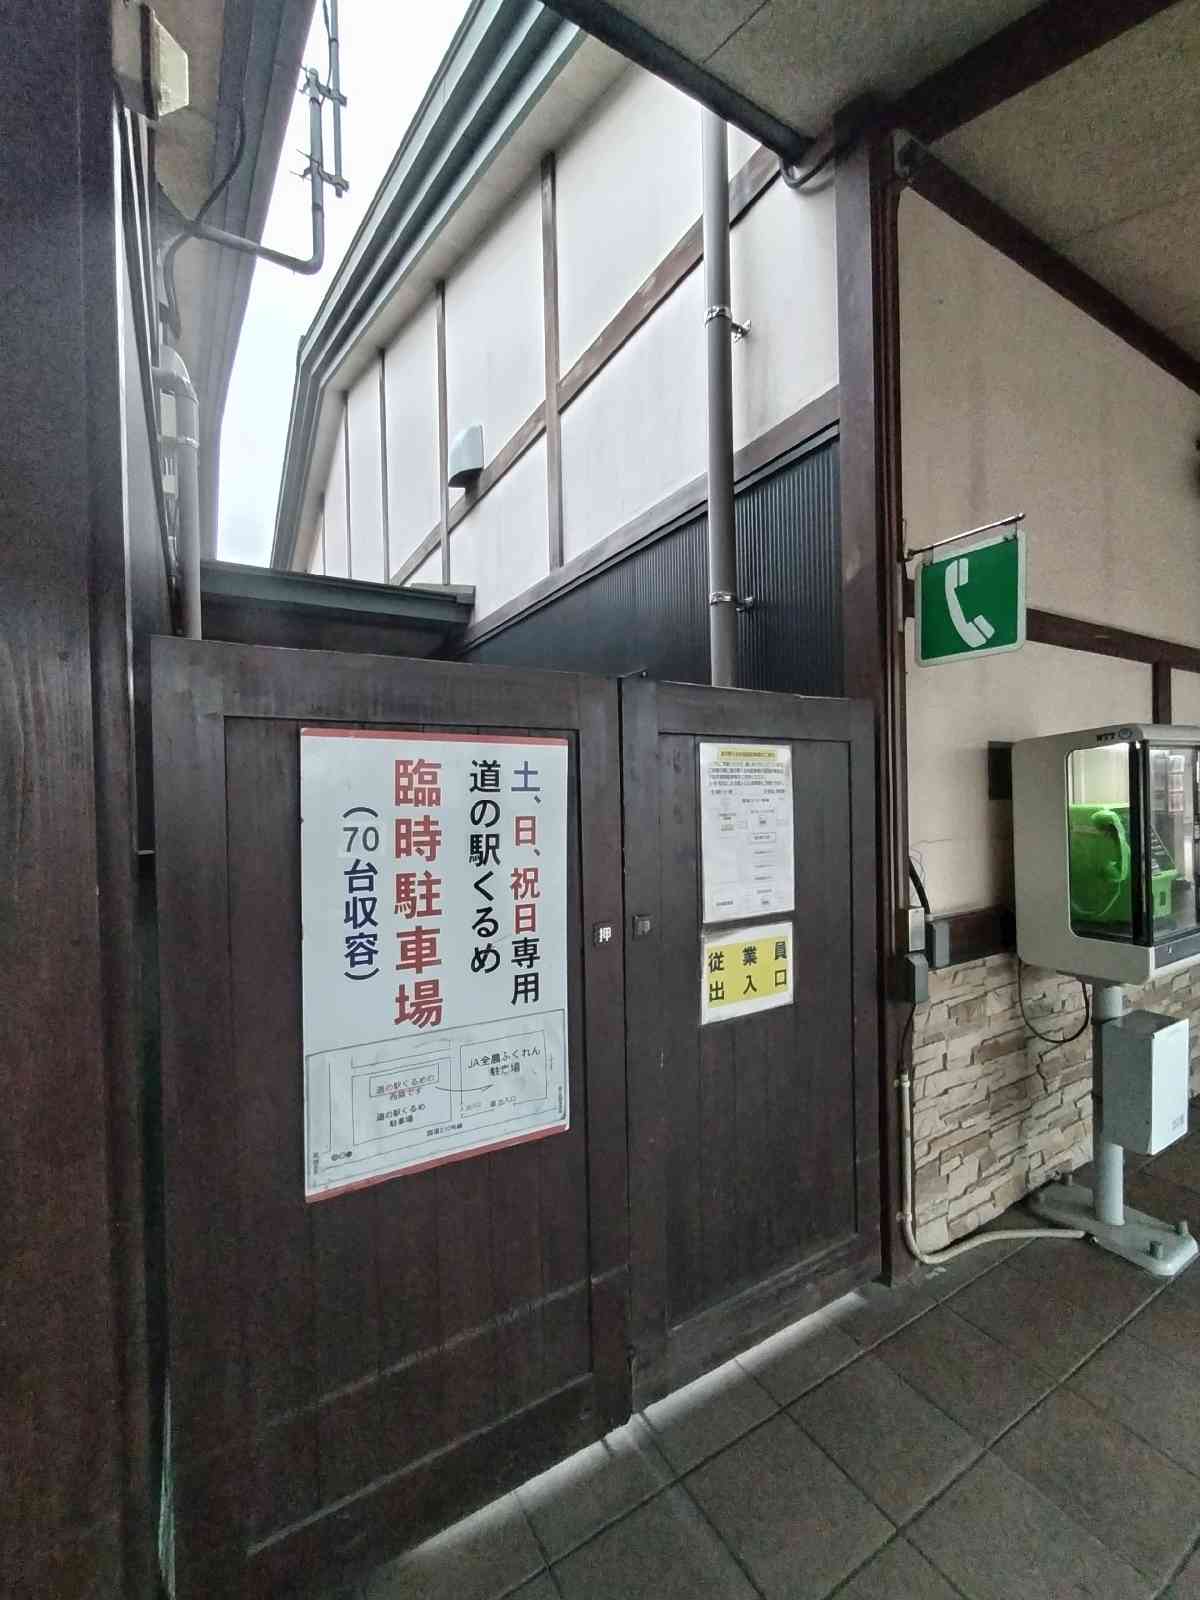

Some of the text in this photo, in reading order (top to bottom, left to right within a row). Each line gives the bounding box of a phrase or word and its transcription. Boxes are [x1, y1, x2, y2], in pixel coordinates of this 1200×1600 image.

[393, 758, 443, 1029] 臨時駐車場
[469, 759, 501, 974] 道の駅くるめ
[510, 760, 541, 1005] 土、日、祝日専用
[708, 941, 787, 973] 従業員
[709, 969, 787, 1003] 出入口
